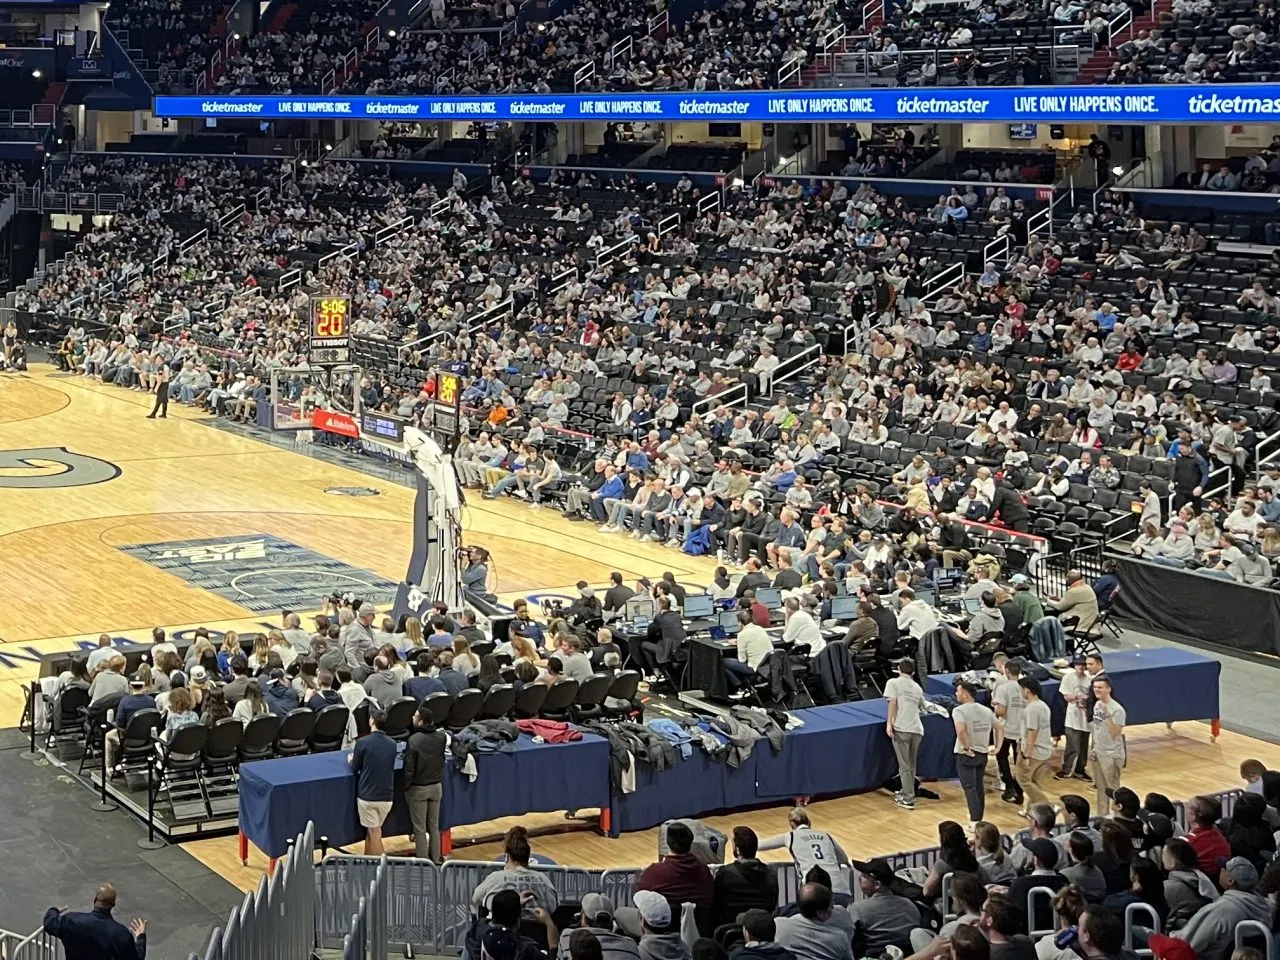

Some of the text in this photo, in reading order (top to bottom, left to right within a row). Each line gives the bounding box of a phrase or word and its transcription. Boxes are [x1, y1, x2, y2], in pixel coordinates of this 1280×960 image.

[897, 97, 989, 112] ticketmaster
[1015, 96, 1158, 112] LIVE ONLY HAPPENS ONCE.
[321, 300, 345, 314] 5:06
[318, 314, 343, 336] 20
[812, 844, 824, 859] 3
